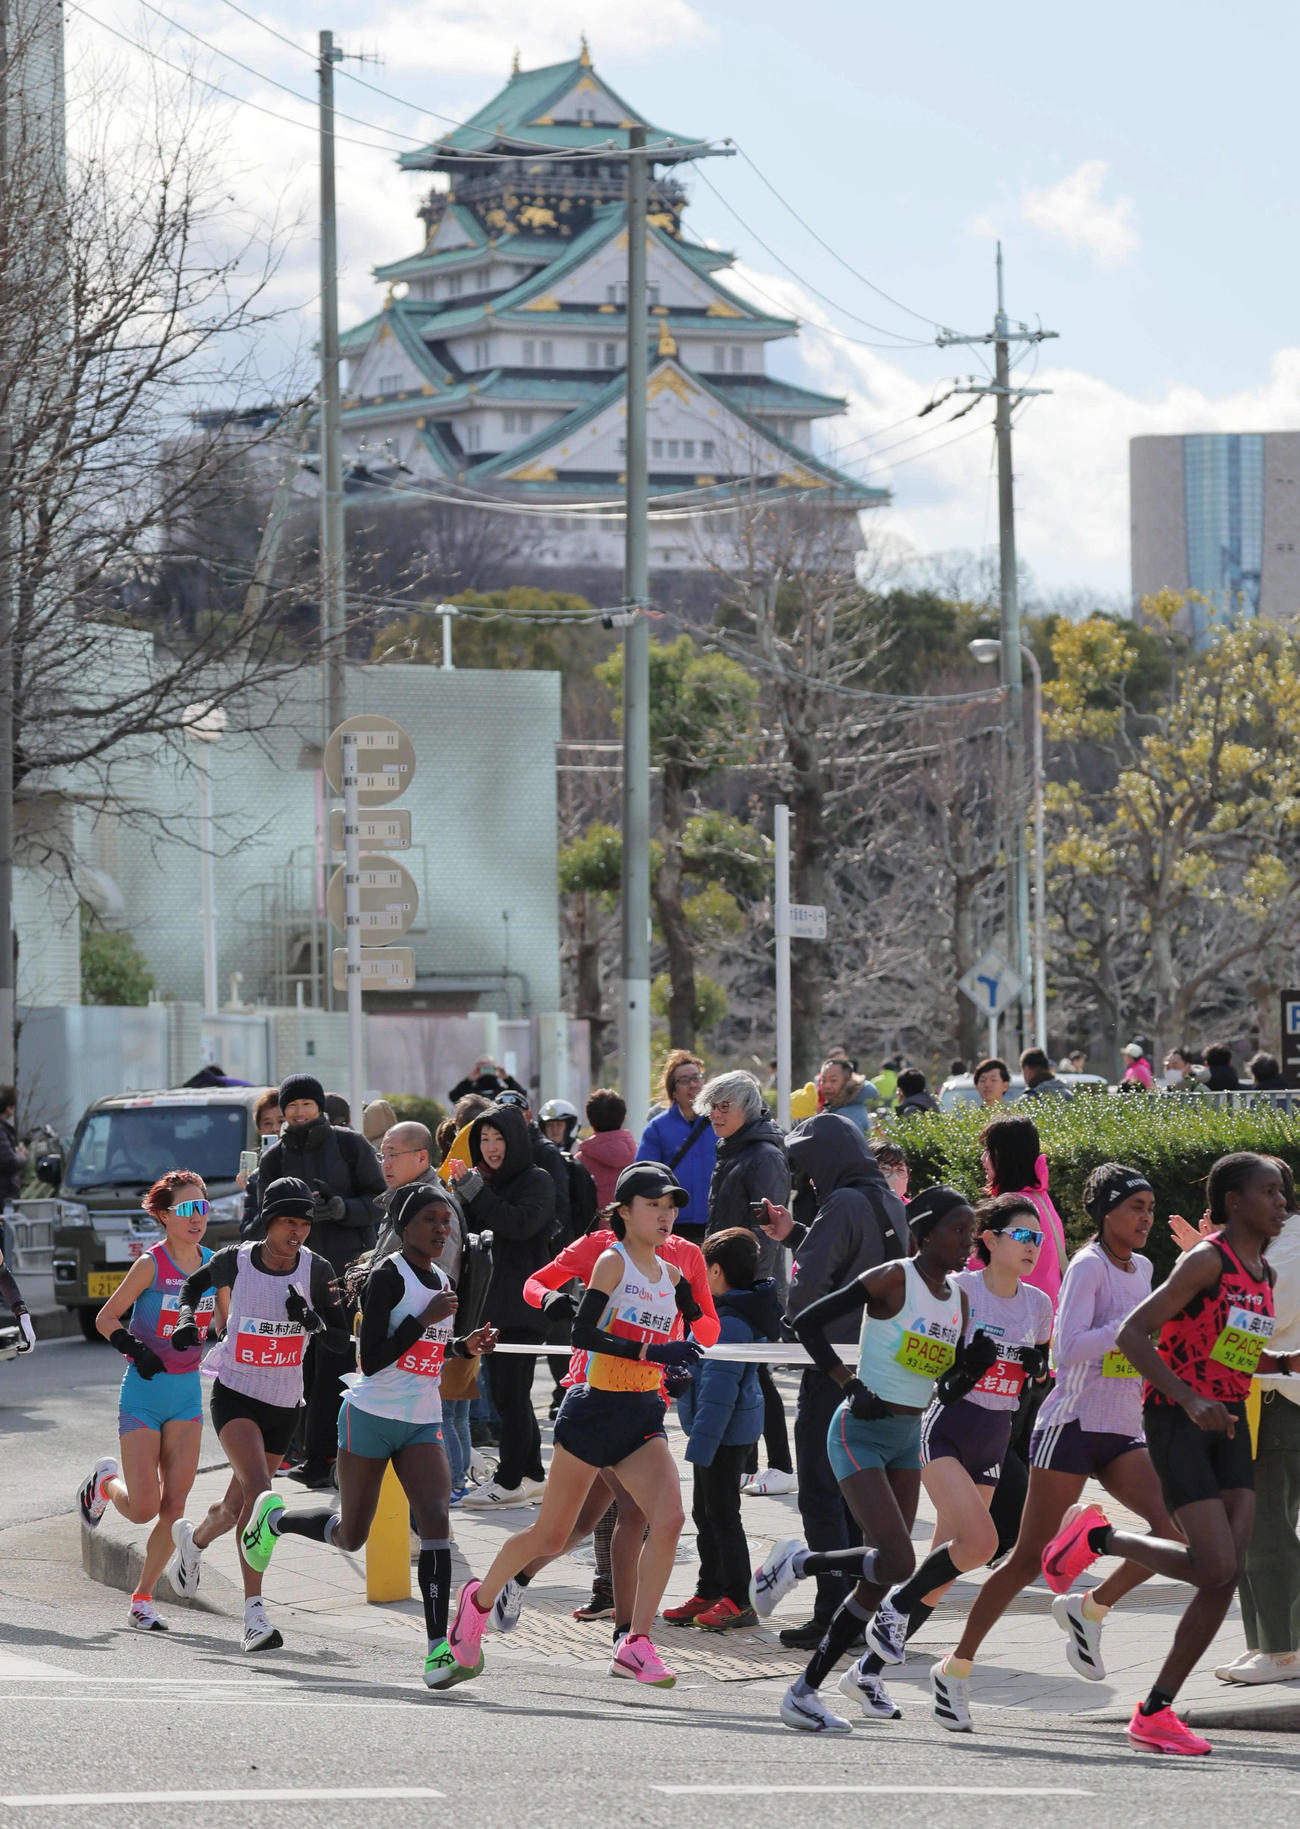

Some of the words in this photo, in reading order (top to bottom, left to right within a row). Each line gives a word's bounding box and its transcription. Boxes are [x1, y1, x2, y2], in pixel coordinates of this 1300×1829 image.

[259, 1322, 302, 1335] 奥村組
[268, 1339, 278, 1350] 3
[1223, 1332, 1264, 1357] PACE
[241, 1349, 298, 1365] B.ヒルバ
[430, 1345, 439, 1358] 2
[997, 1362, 1006, 1376] 5
